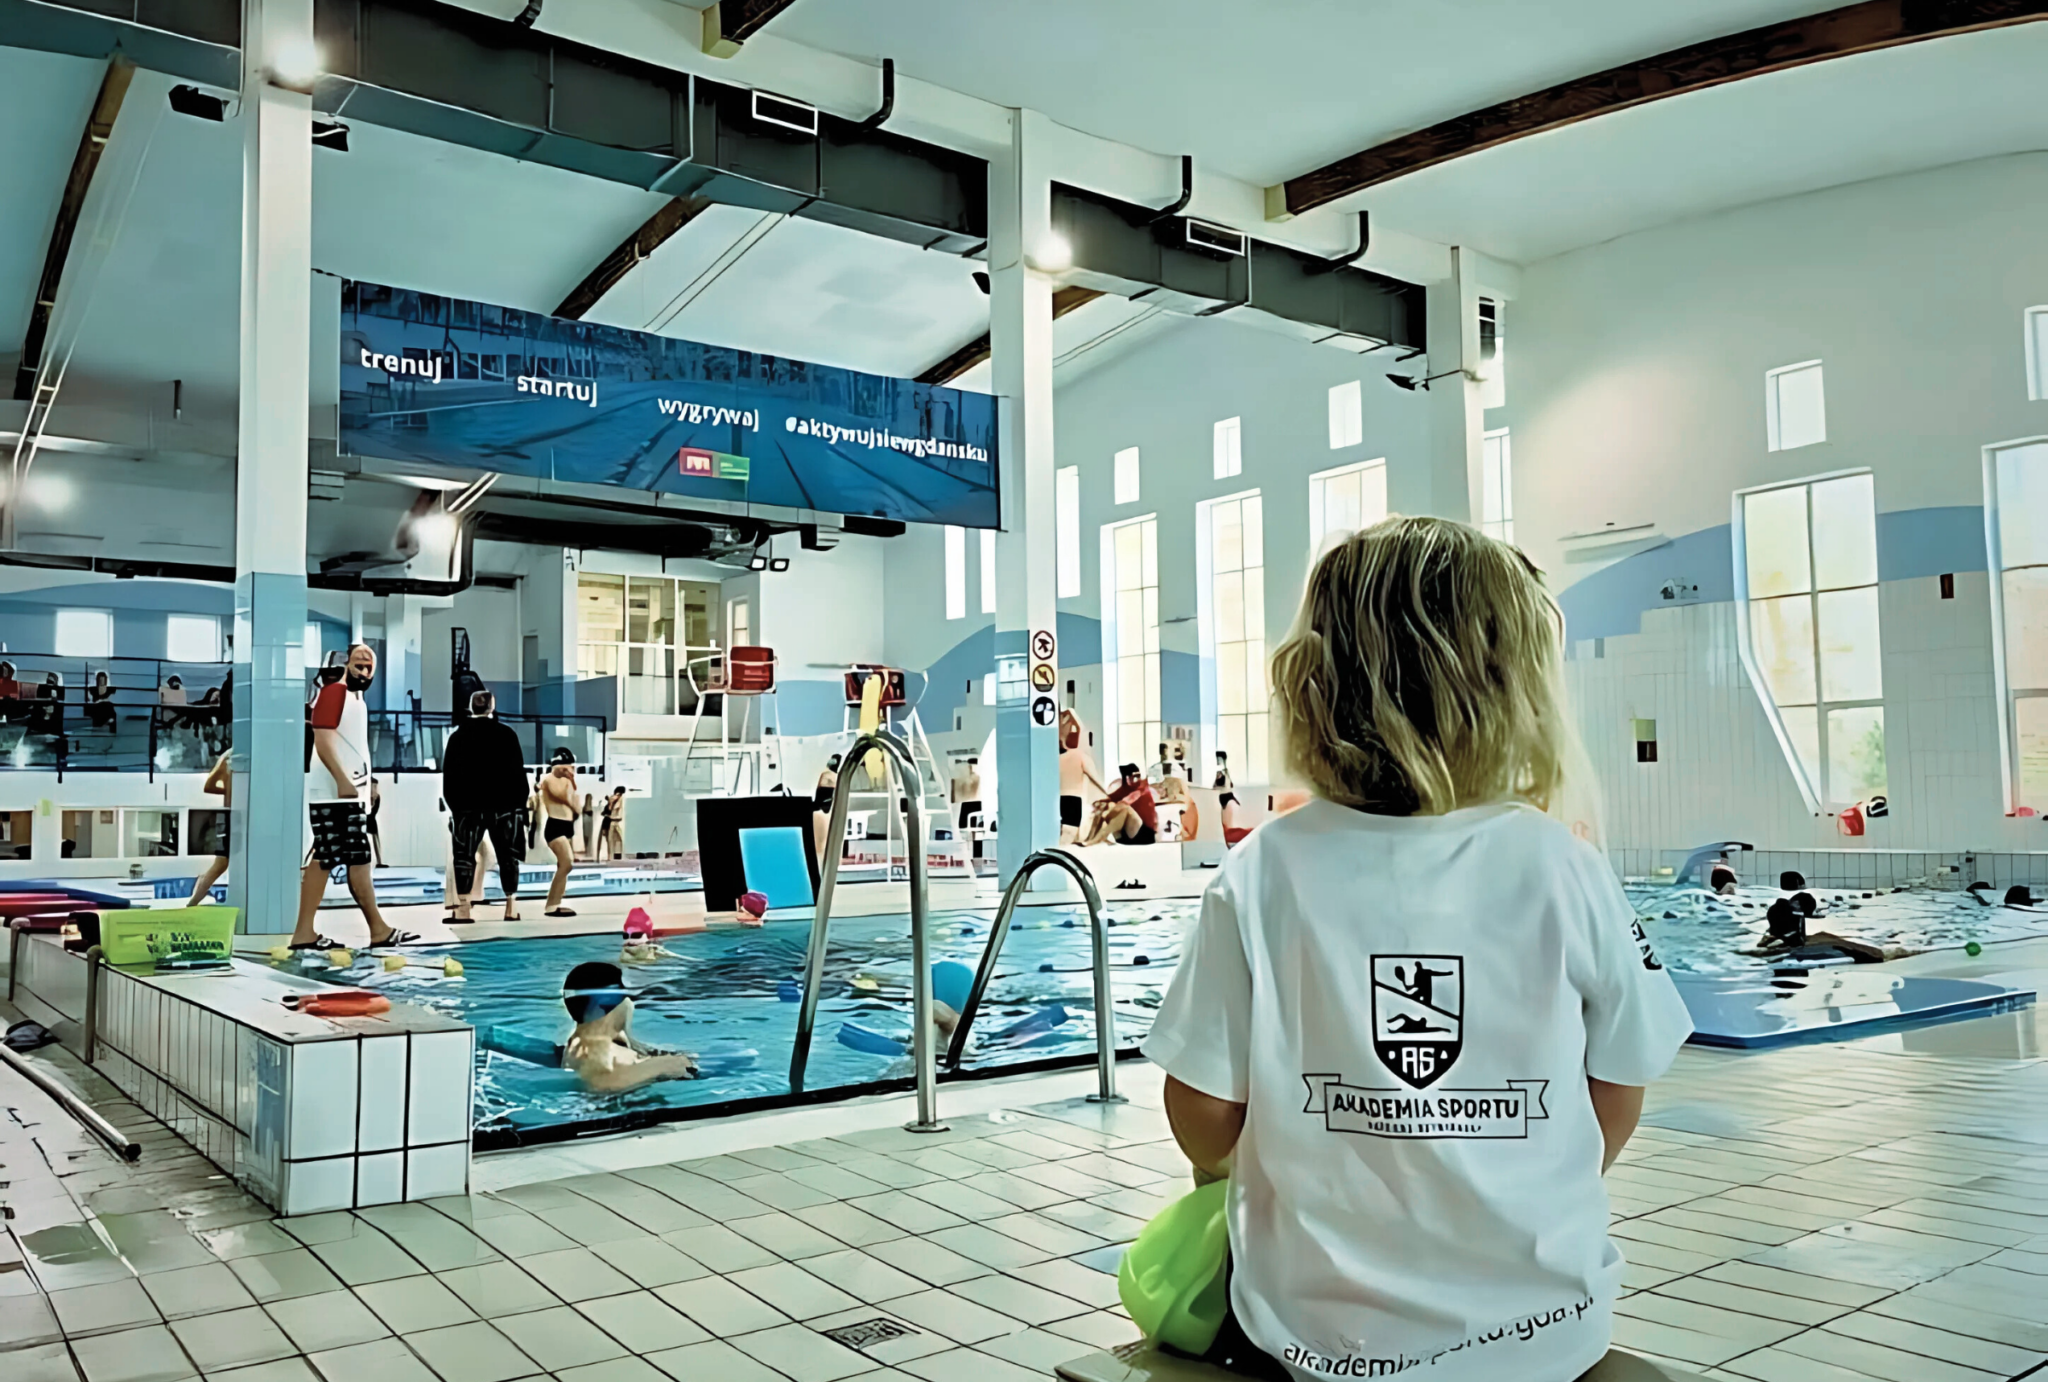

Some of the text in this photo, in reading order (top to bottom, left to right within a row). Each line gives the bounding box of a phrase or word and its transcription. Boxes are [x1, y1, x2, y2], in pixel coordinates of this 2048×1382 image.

[361, 347, 442, 385] trenuj
[517, 375, 598, 408] startuj
[658, 398, 759, 432] wygrywaj
[1437, 1098, 1519, 1119] SPORTU
